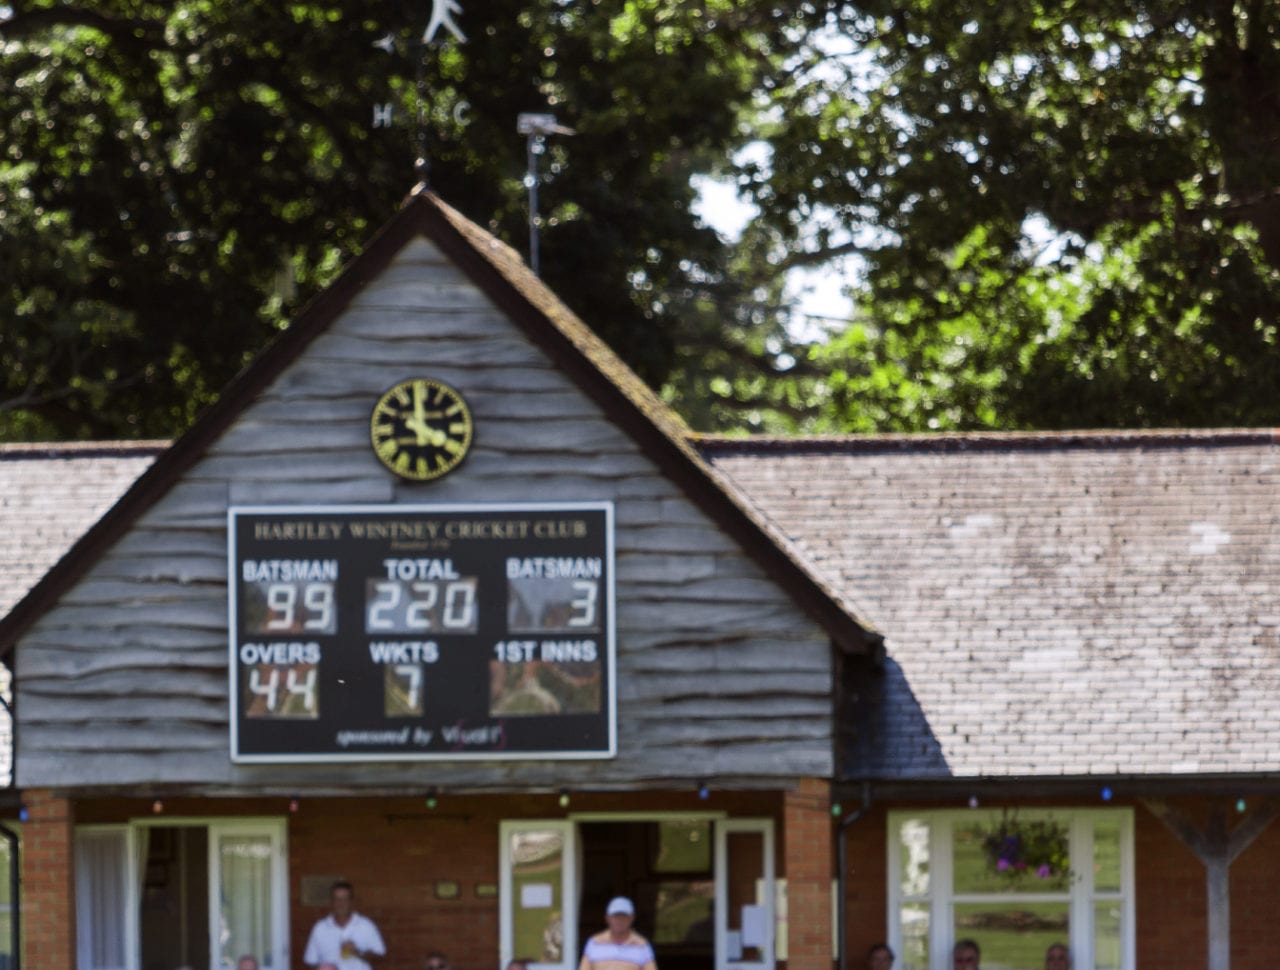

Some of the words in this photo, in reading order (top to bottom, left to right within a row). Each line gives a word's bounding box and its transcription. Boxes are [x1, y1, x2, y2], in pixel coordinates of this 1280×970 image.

[255, 522, 342, 540] HARTLEY
[350, 521, 439, 538] WINTNEY
[446, 520, 530, 537] CRICKET
[534, 519, 587, 536] CLUB
[243, 559, 338, 581] BATSMAN
[384, 559, 458, 580] TOTAL
[506, 557, 602, 578] BATSMAN
[267, 583, 334, 630] 99
[368, 581, 477, 628] 220
[568, 580, 597, 627] 3
[240, 643, 321, 664] OVERS
[369, 641, 439, 662] WKTS
[494, 641, 538, 662] 1ST
[541, 641, 598, 662] INNS
[248, 668, 317, 711] 44
[395, 665, 422, 710] 7
